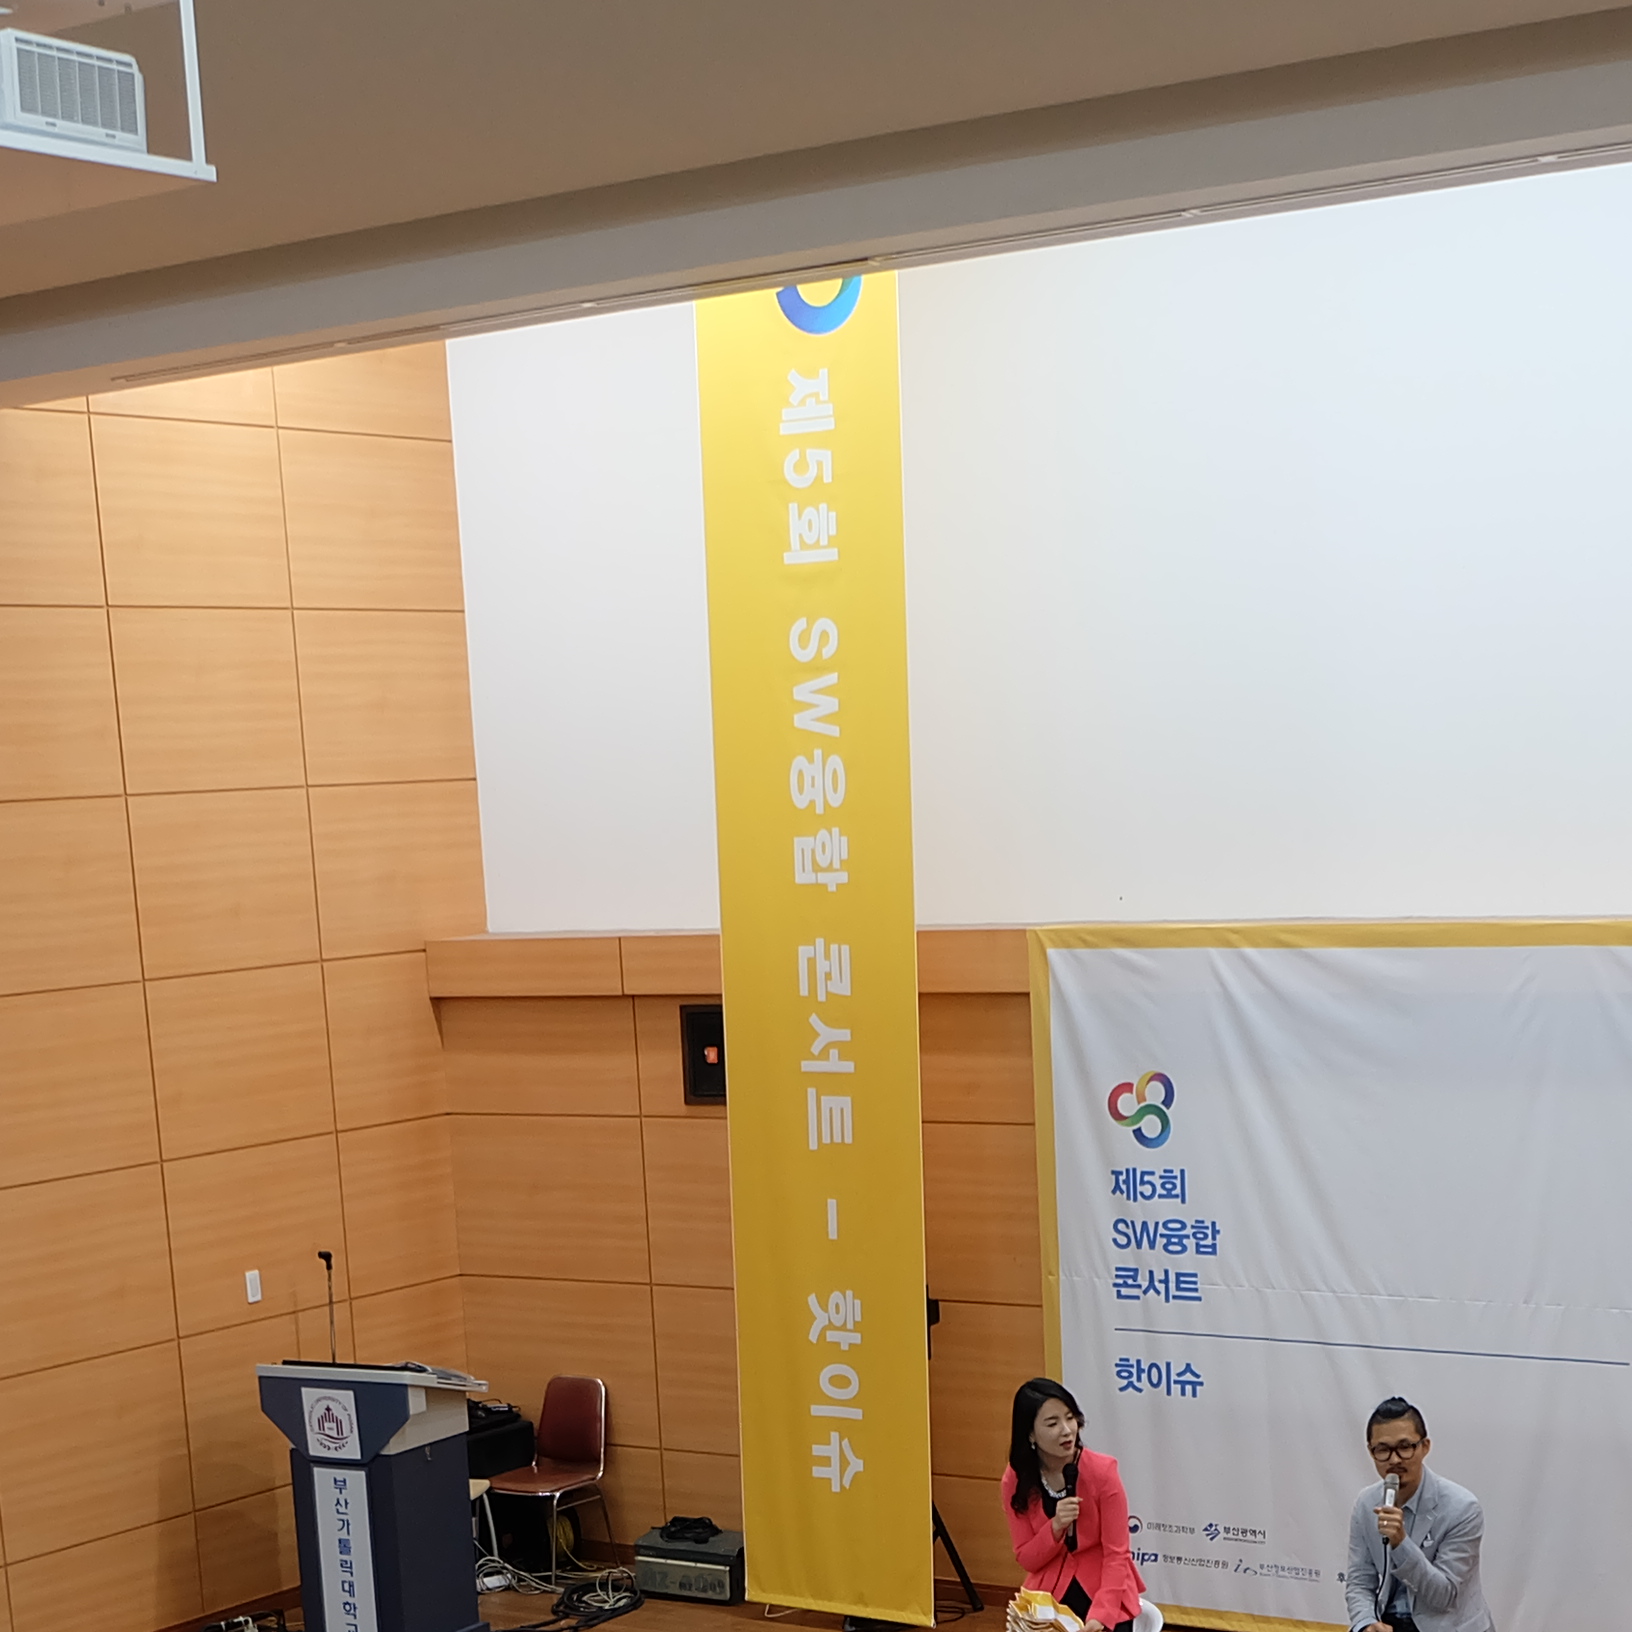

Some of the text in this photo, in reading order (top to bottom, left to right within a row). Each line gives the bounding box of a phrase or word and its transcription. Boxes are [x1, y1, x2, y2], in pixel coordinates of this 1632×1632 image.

[779, 368, 839, 565] 제5회
[788, 617, 850, 892] SW융합
[797, 936, 855, 1150] 콘서트
[1110, 1167, 1187, 1204] 제5회
[1111, 1219, 1221, 1256] SW융합
[1111, 1266, 1202, 1303] 콘서트
[807, 1289, 864, 1492] 핫이슈
[1114, 1357, 1204, 1398] 핫이슈
[1223, 1525, 1266, 1540] 부산광역시
